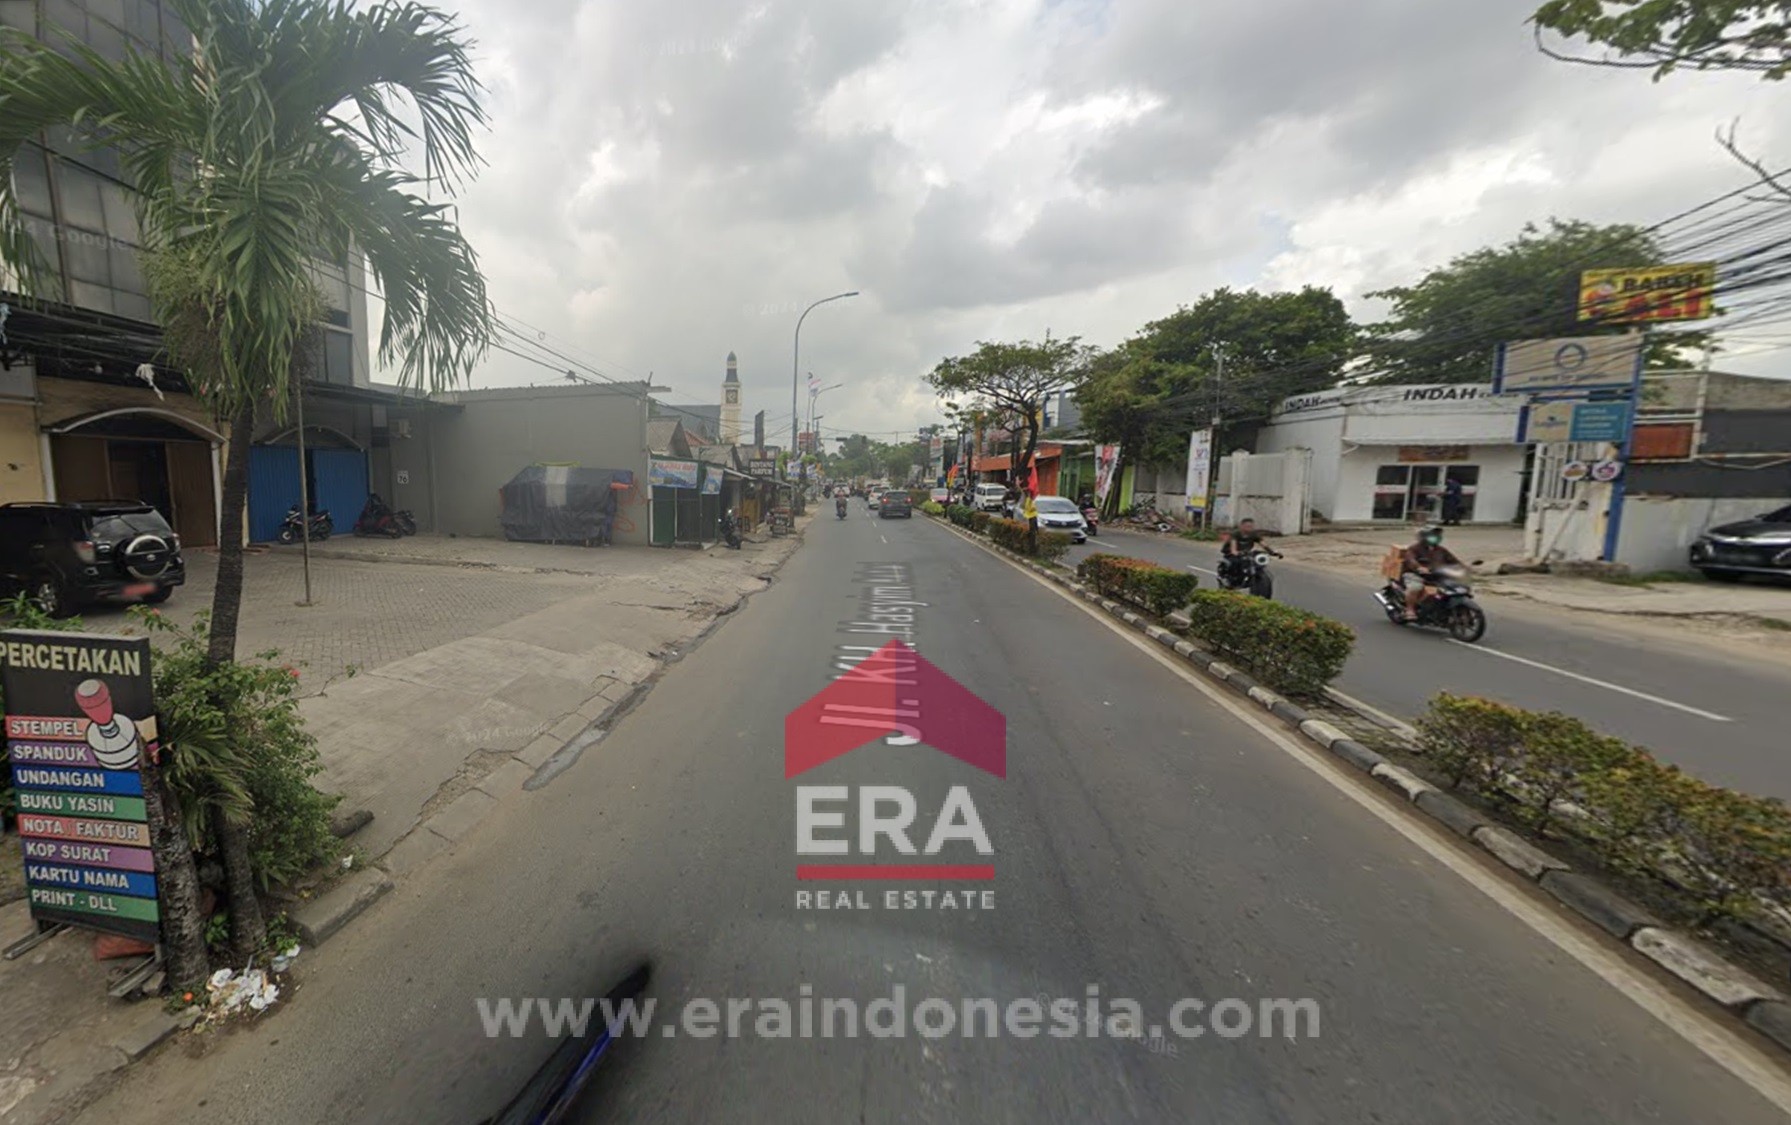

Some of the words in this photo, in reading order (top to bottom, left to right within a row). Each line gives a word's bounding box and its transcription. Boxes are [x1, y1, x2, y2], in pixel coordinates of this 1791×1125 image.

[1403, 387, 1478, 400] INDAH
[0, 641, 141, 677] PERCETAKAN
[11, 719, 83, 737] STEMPEL
[14, 744, 88, 762] SPANDUK
[16, 769, 104, 788] UNDANGAN
[20, 794, 63, 810] BUKU
[67, 798, 115, 813] YASIN
[23, 818, 64, 834] NOTA
[76, 822, 139, 840] FAKTUR
[25, 842, 56, 857] KOP
[61, 845, 111, 862] SURAT
[28, 866, 80, 883] KARTU
[84, 871, 129, 888] NAMA
[31, 889, 75, 906] PRINT
[89, 895, 117, 911] DLL
